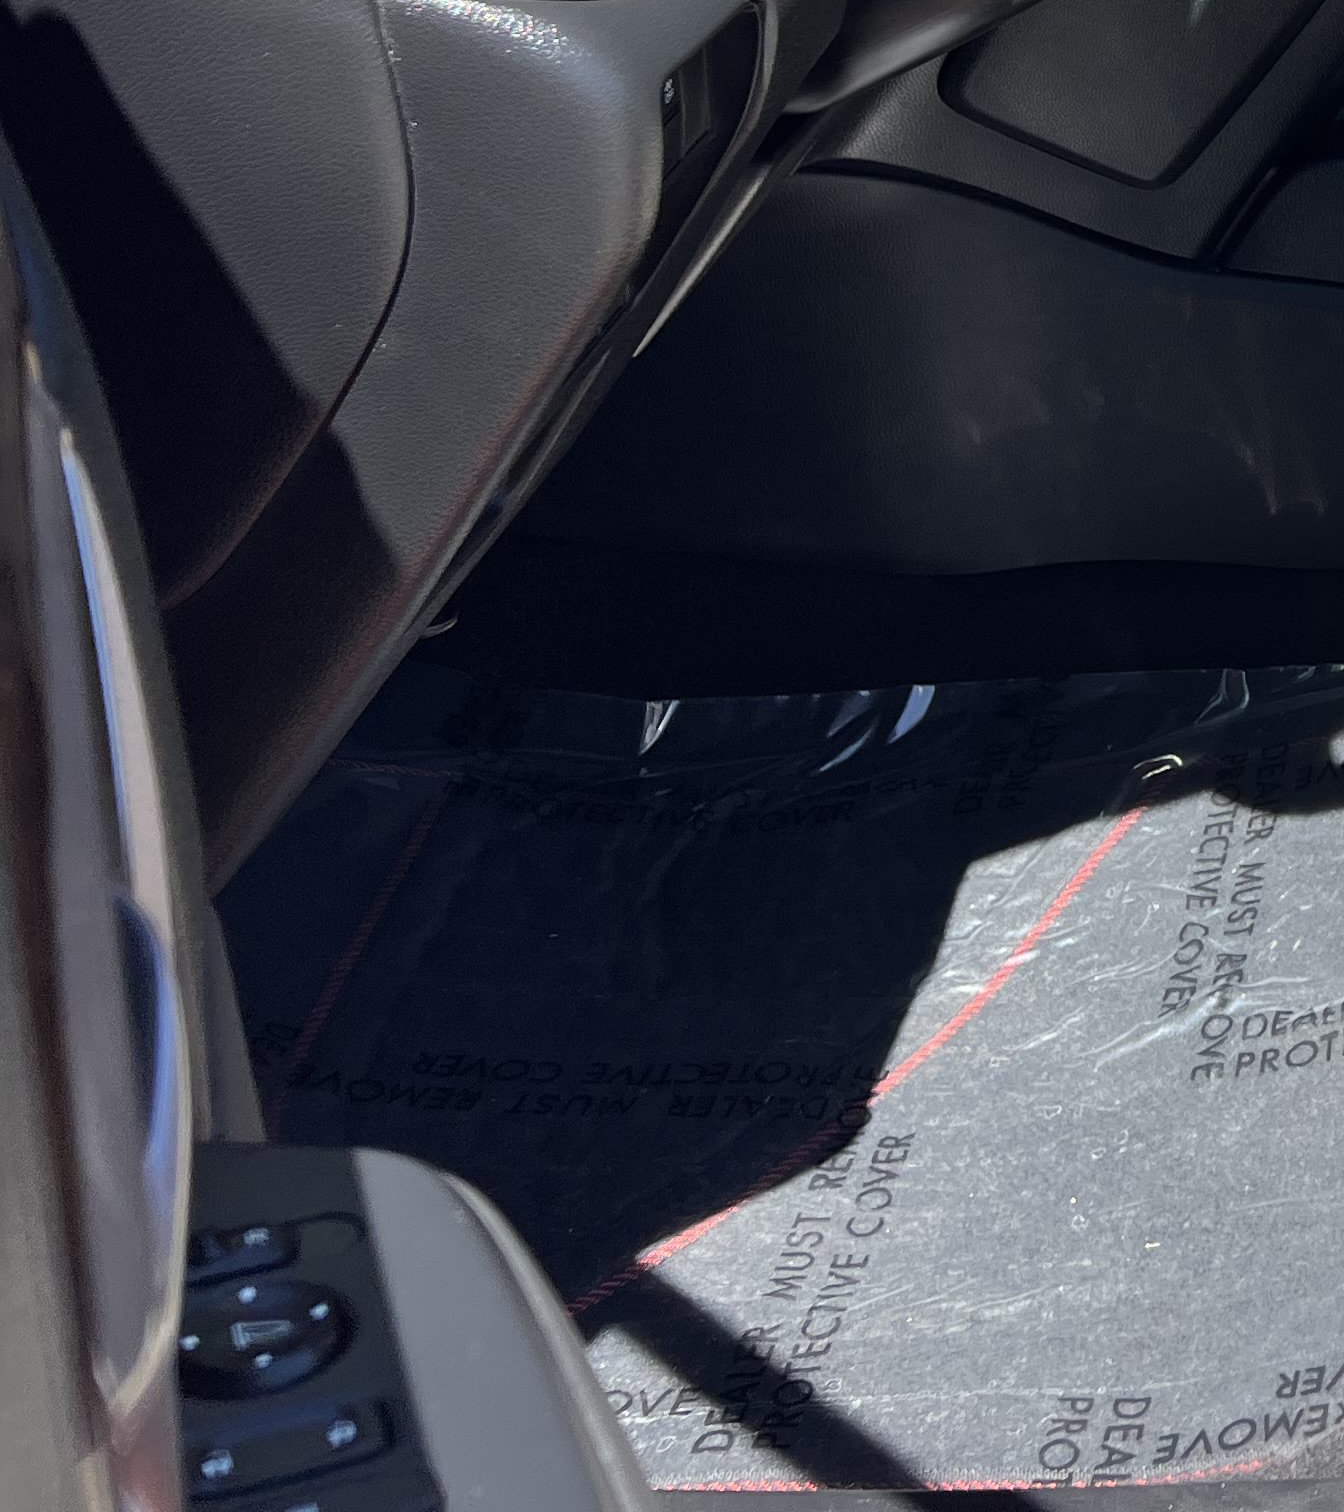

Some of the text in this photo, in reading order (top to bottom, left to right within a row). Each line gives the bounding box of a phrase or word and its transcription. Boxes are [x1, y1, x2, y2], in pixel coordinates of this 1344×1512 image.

[1157, 754, 1249, 1019] PROTECTIVE COVER
[1223, 861, 1265, 937] MUST
[286, 1066, 829, 1122] DEALER MUST REMOVE
[410, 1050, 838, 1088] PROTECTIVE COVER
[691, 1324, 782, 1455] DEALER
[762, 1212, 832, 1301] MUST
[751, 1131, 916, 1450] PROTECTIVE COVER
